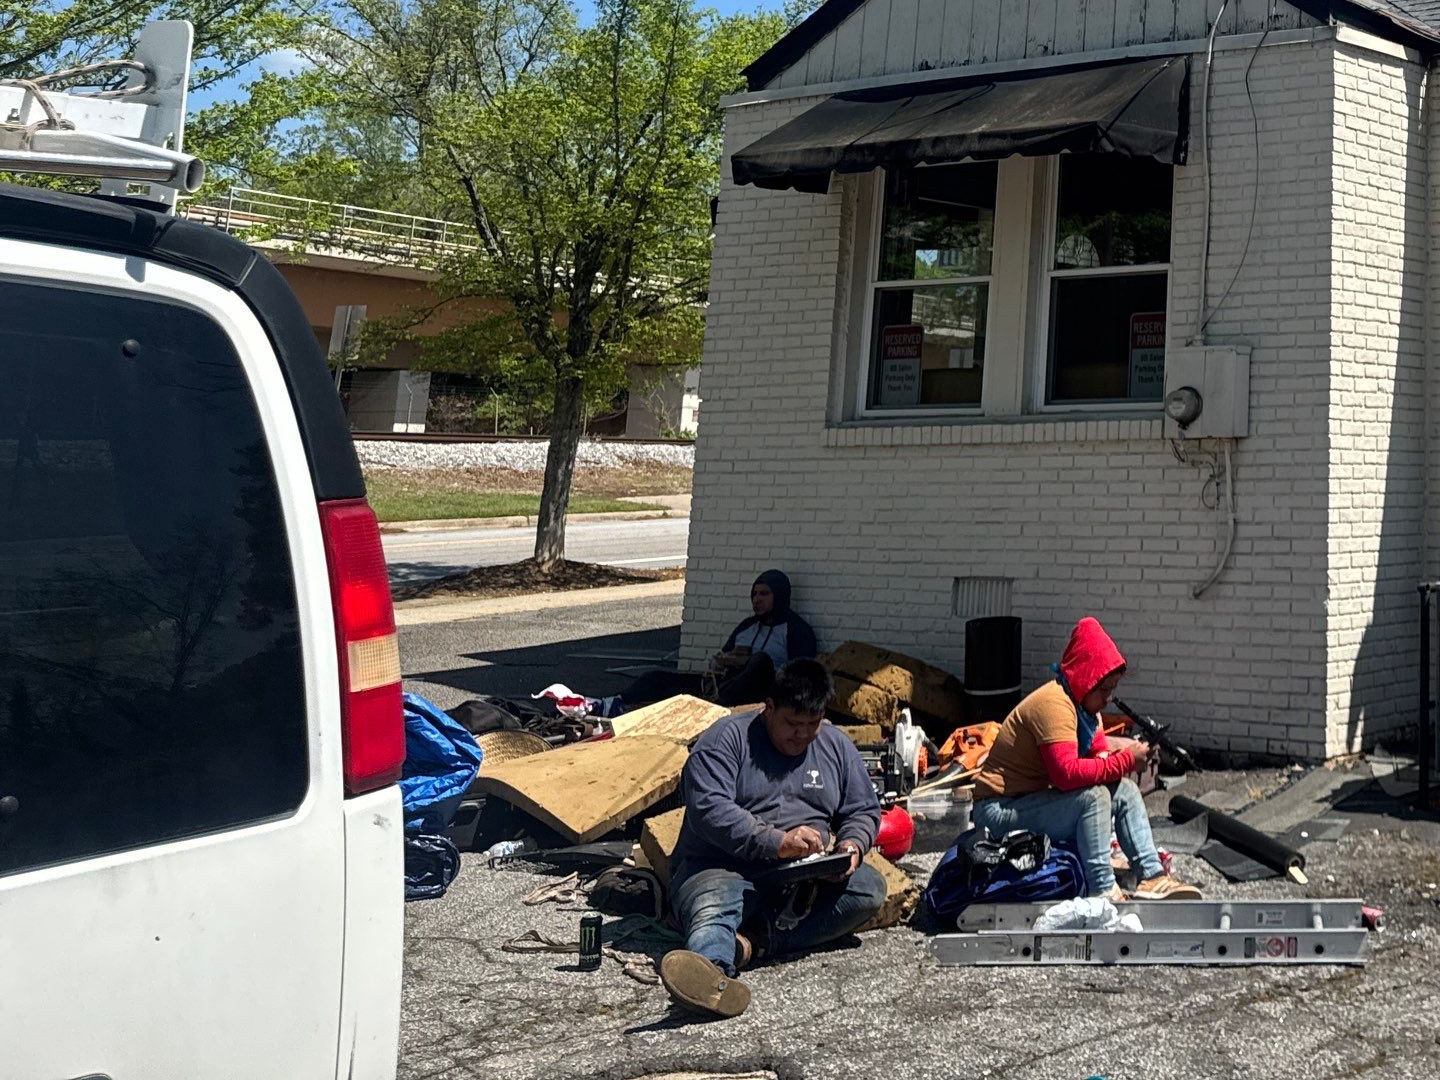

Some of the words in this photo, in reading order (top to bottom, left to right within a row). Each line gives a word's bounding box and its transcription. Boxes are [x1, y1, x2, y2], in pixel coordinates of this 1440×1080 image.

[1134, 321, 1165, 333] RESERV
[885, 334, 921, 345] RESERVED
[1137, 335, 1165, 345] PARKIN
[887, 345, 918, 357] PARKING
